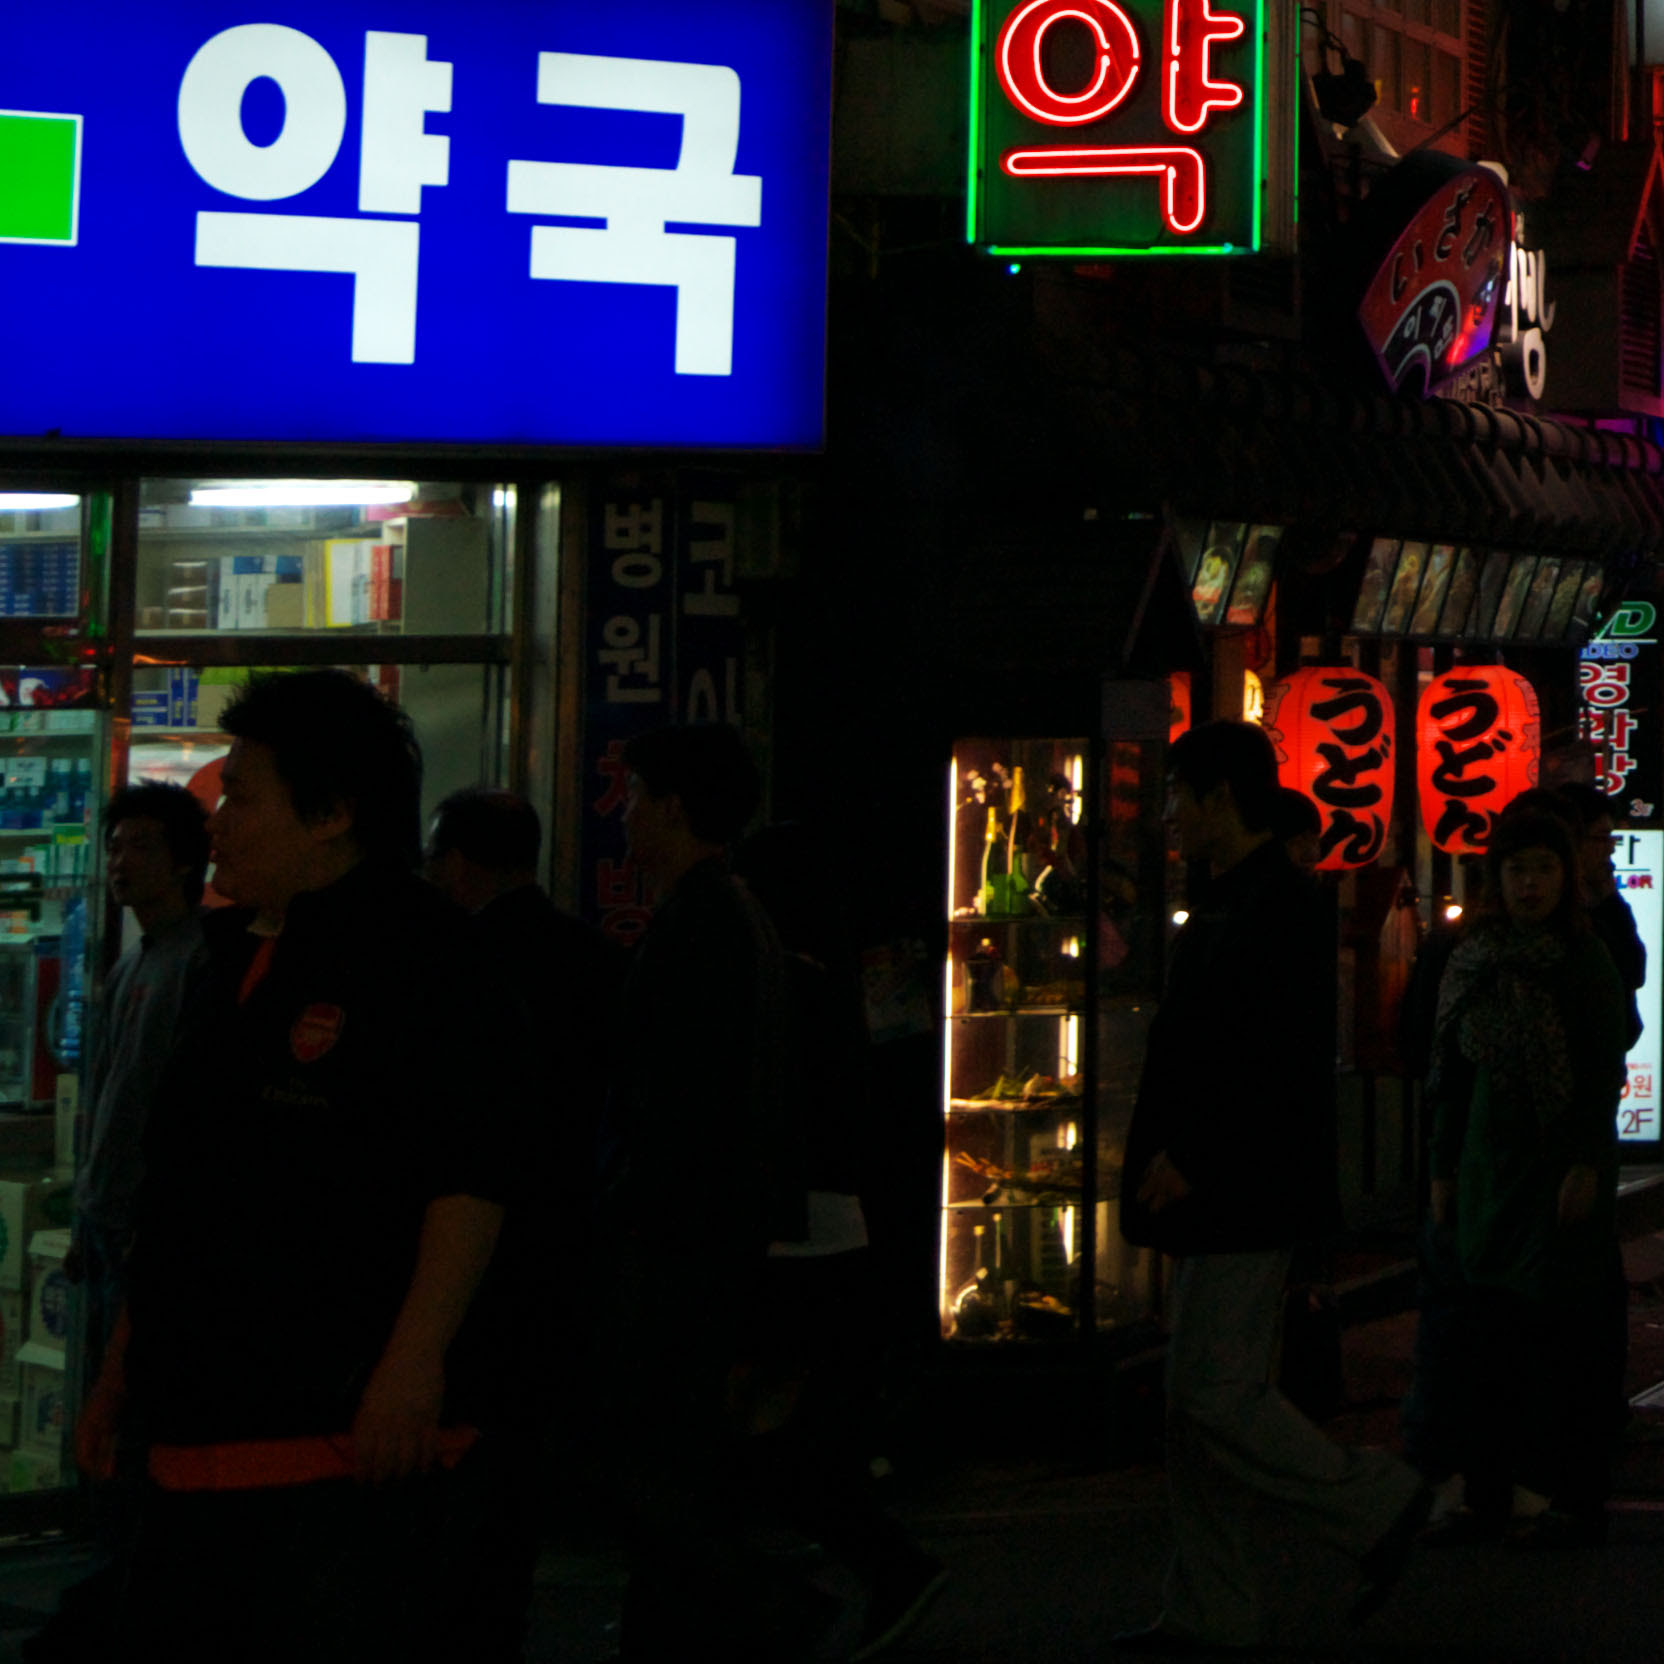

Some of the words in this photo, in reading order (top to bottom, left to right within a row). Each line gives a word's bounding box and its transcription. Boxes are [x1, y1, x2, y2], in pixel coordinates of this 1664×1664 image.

[176, 21, 764, 378] 약국
[597, 498, 661, 706] 병원
[1309, 677, 1386, 866] うどん
[1429, 677, 1508, 855] うどん
[1621, 1108, 1655, 1135] 2F
